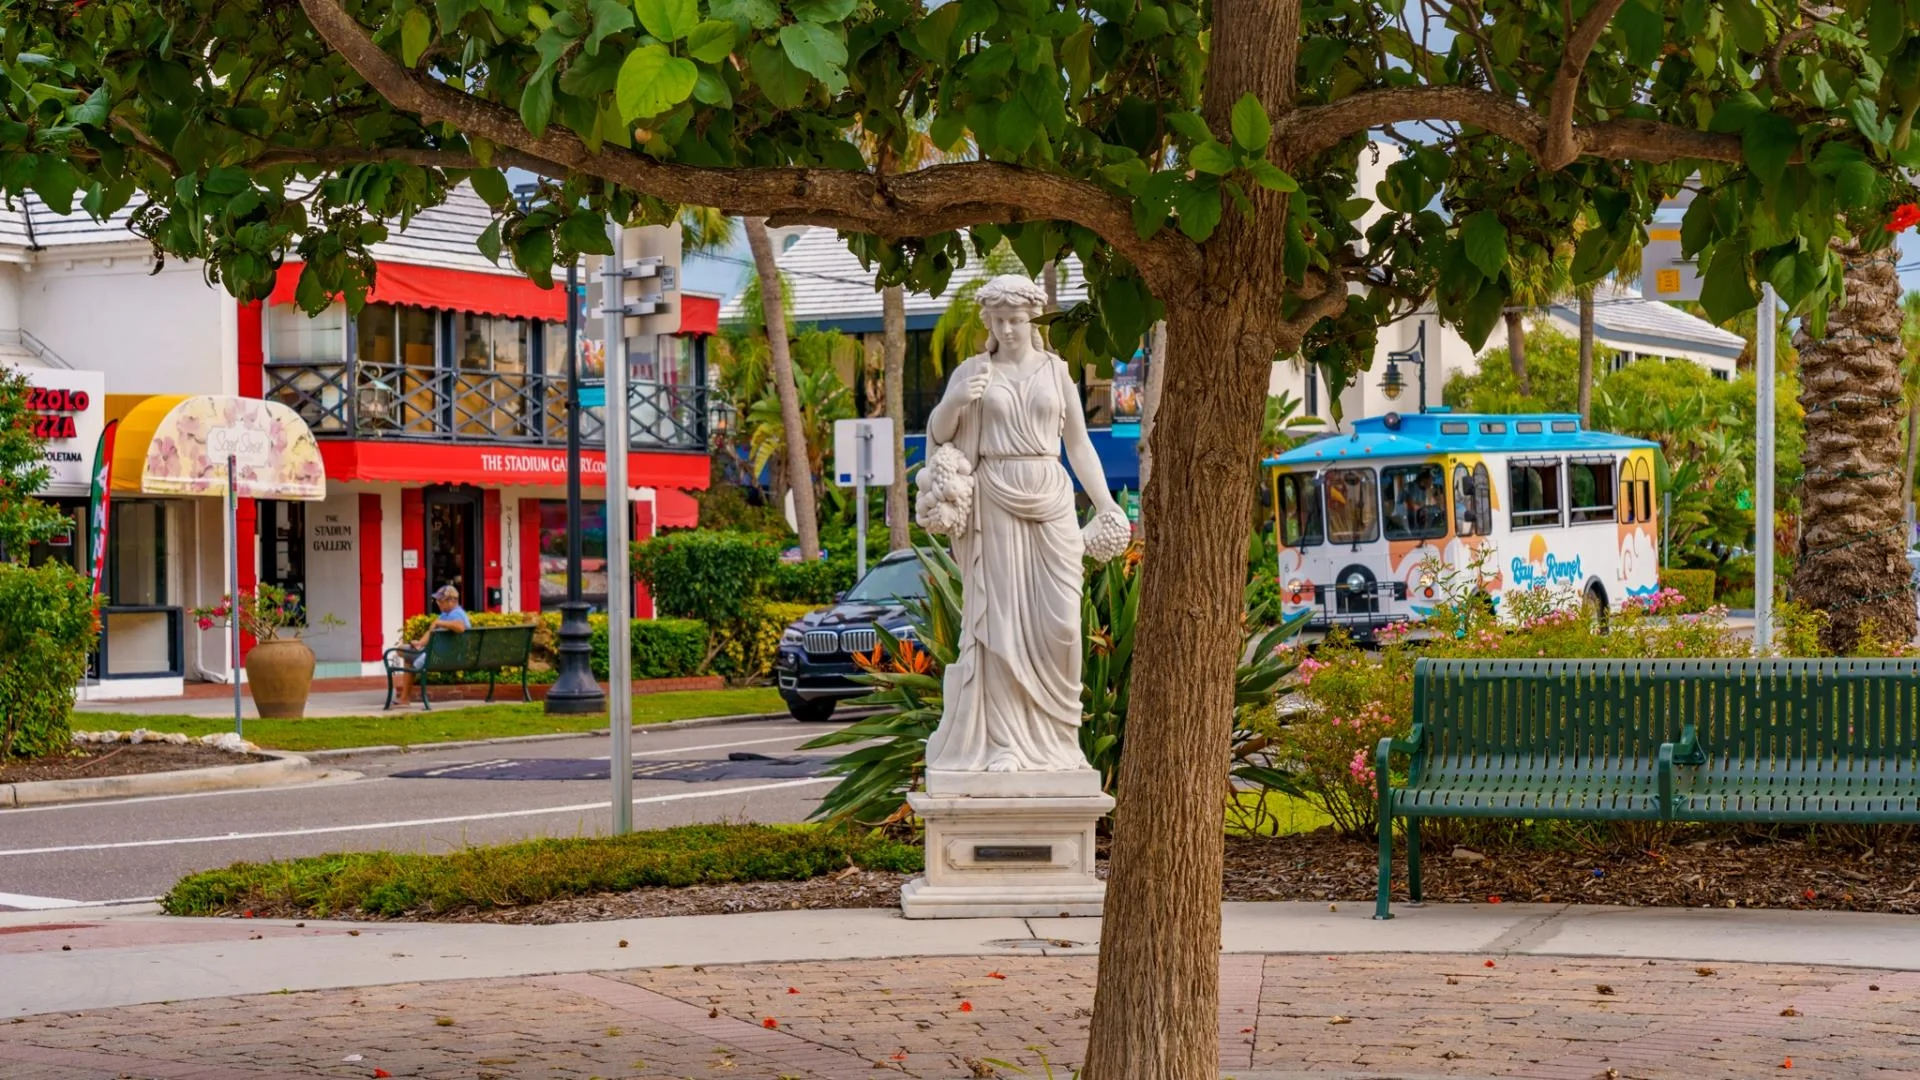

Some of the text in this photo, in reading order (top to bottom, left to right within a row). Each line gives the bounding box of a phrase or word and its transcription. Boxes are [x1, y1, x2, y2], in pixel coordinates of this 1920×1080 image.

[25, 387, 89, 411] ZZOLO
[36, 415, 77, 438] ZZA
[481, 455, 607, 473] THE STADIUM GARY.co
[314, 525, 352, 536] STADIUM
[313, 541, 352, 551] GALLERY
[1511, 553, 1583, 591] Bay Runner
